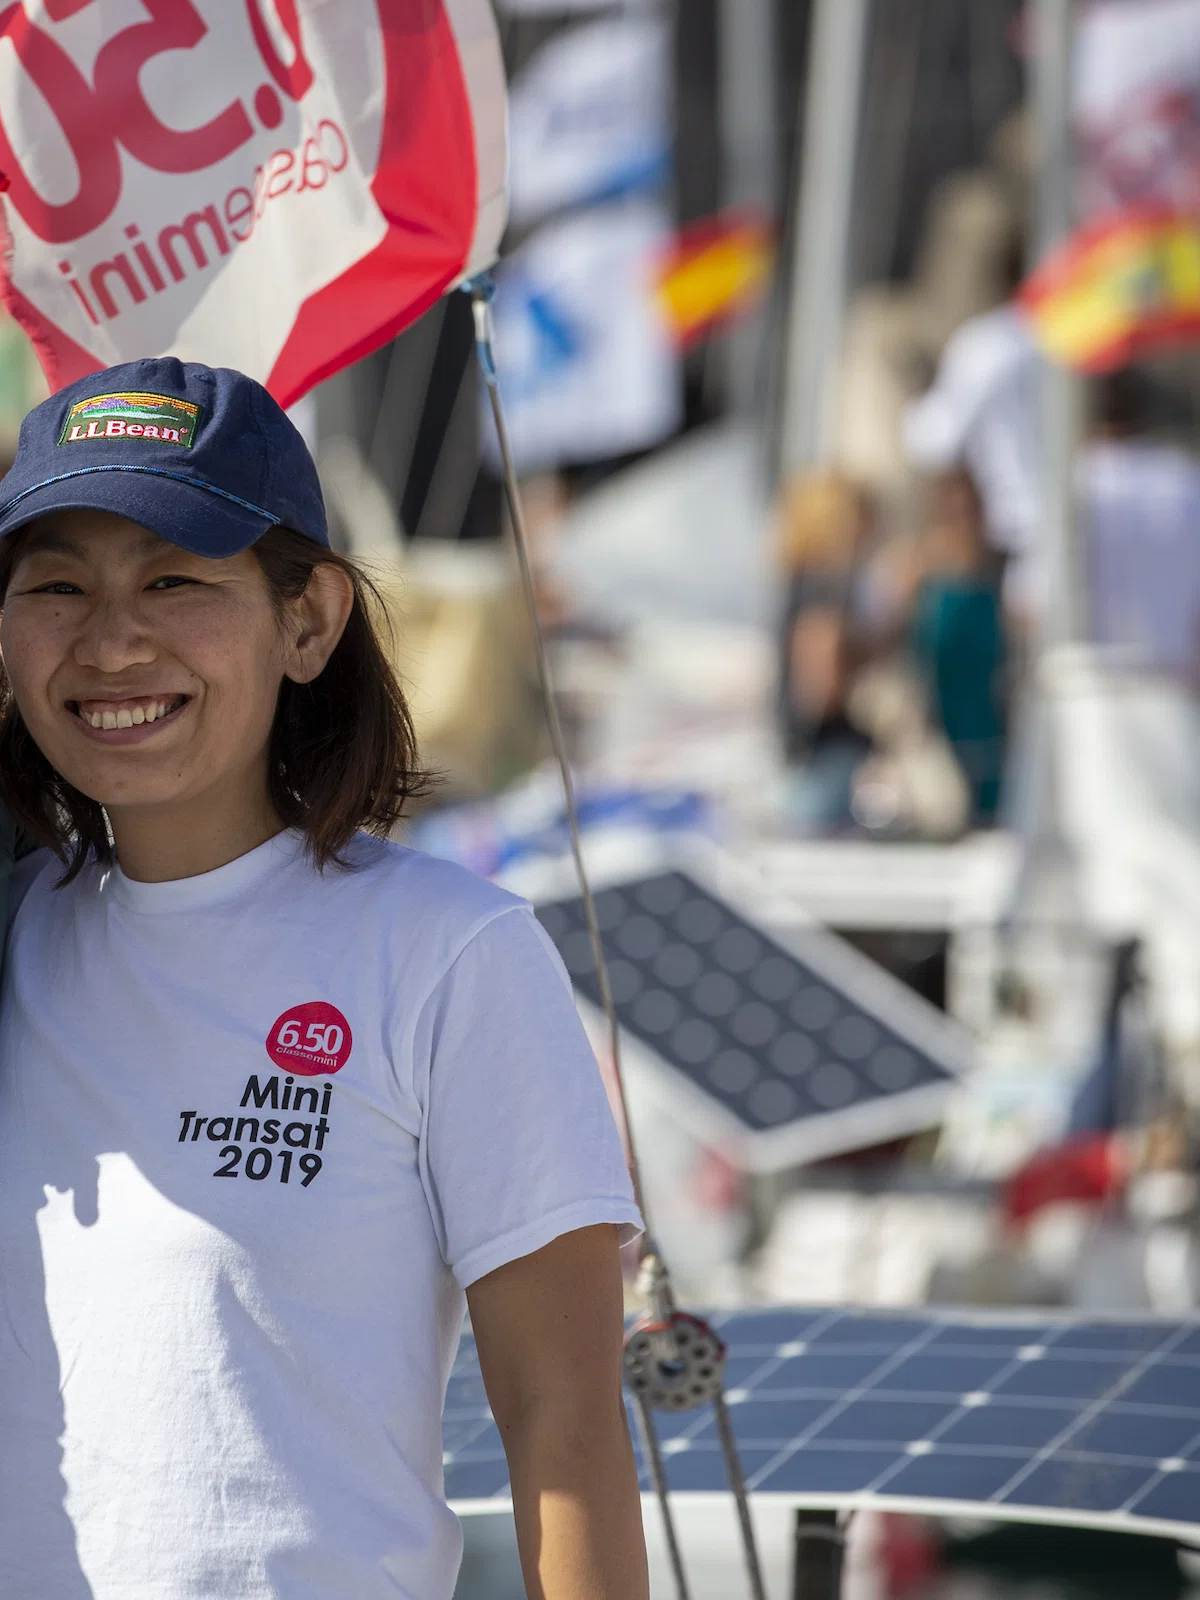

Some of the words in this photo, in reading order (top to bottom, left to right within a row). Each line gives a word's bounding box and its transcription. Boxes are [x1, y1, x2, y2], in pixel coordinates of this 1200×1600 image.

[277, 1020, 344, 1055] 6.50
[239, 1074, 333, 1115] Mini
[178, 1111, 330, 1151] Transat
[213, 1145, 323, 1188] 2019
